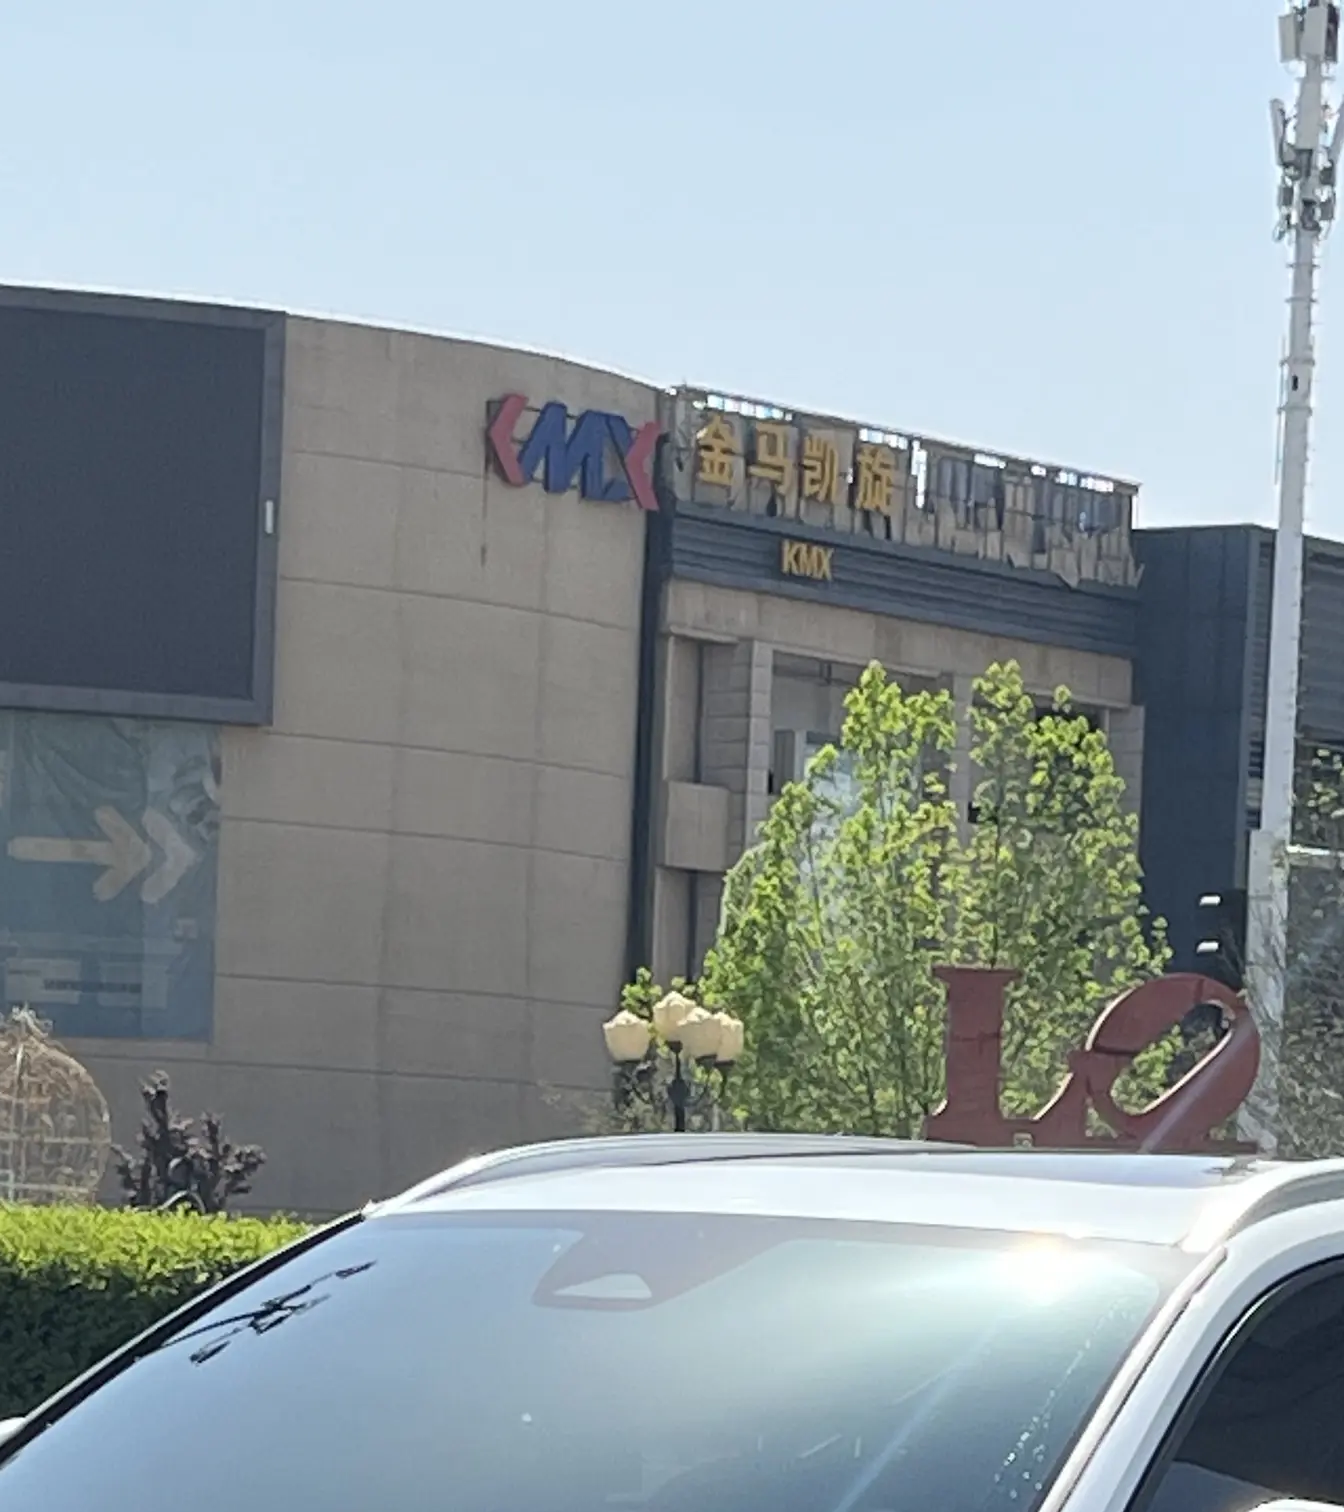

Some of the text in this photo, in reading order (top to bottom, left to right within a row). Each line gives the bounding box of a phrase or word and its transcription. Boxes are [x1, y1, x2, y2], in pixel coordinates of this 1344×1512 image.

[696, 413, 897, 517] 金马凯旋
[781, 538, 836, 583] KMX
